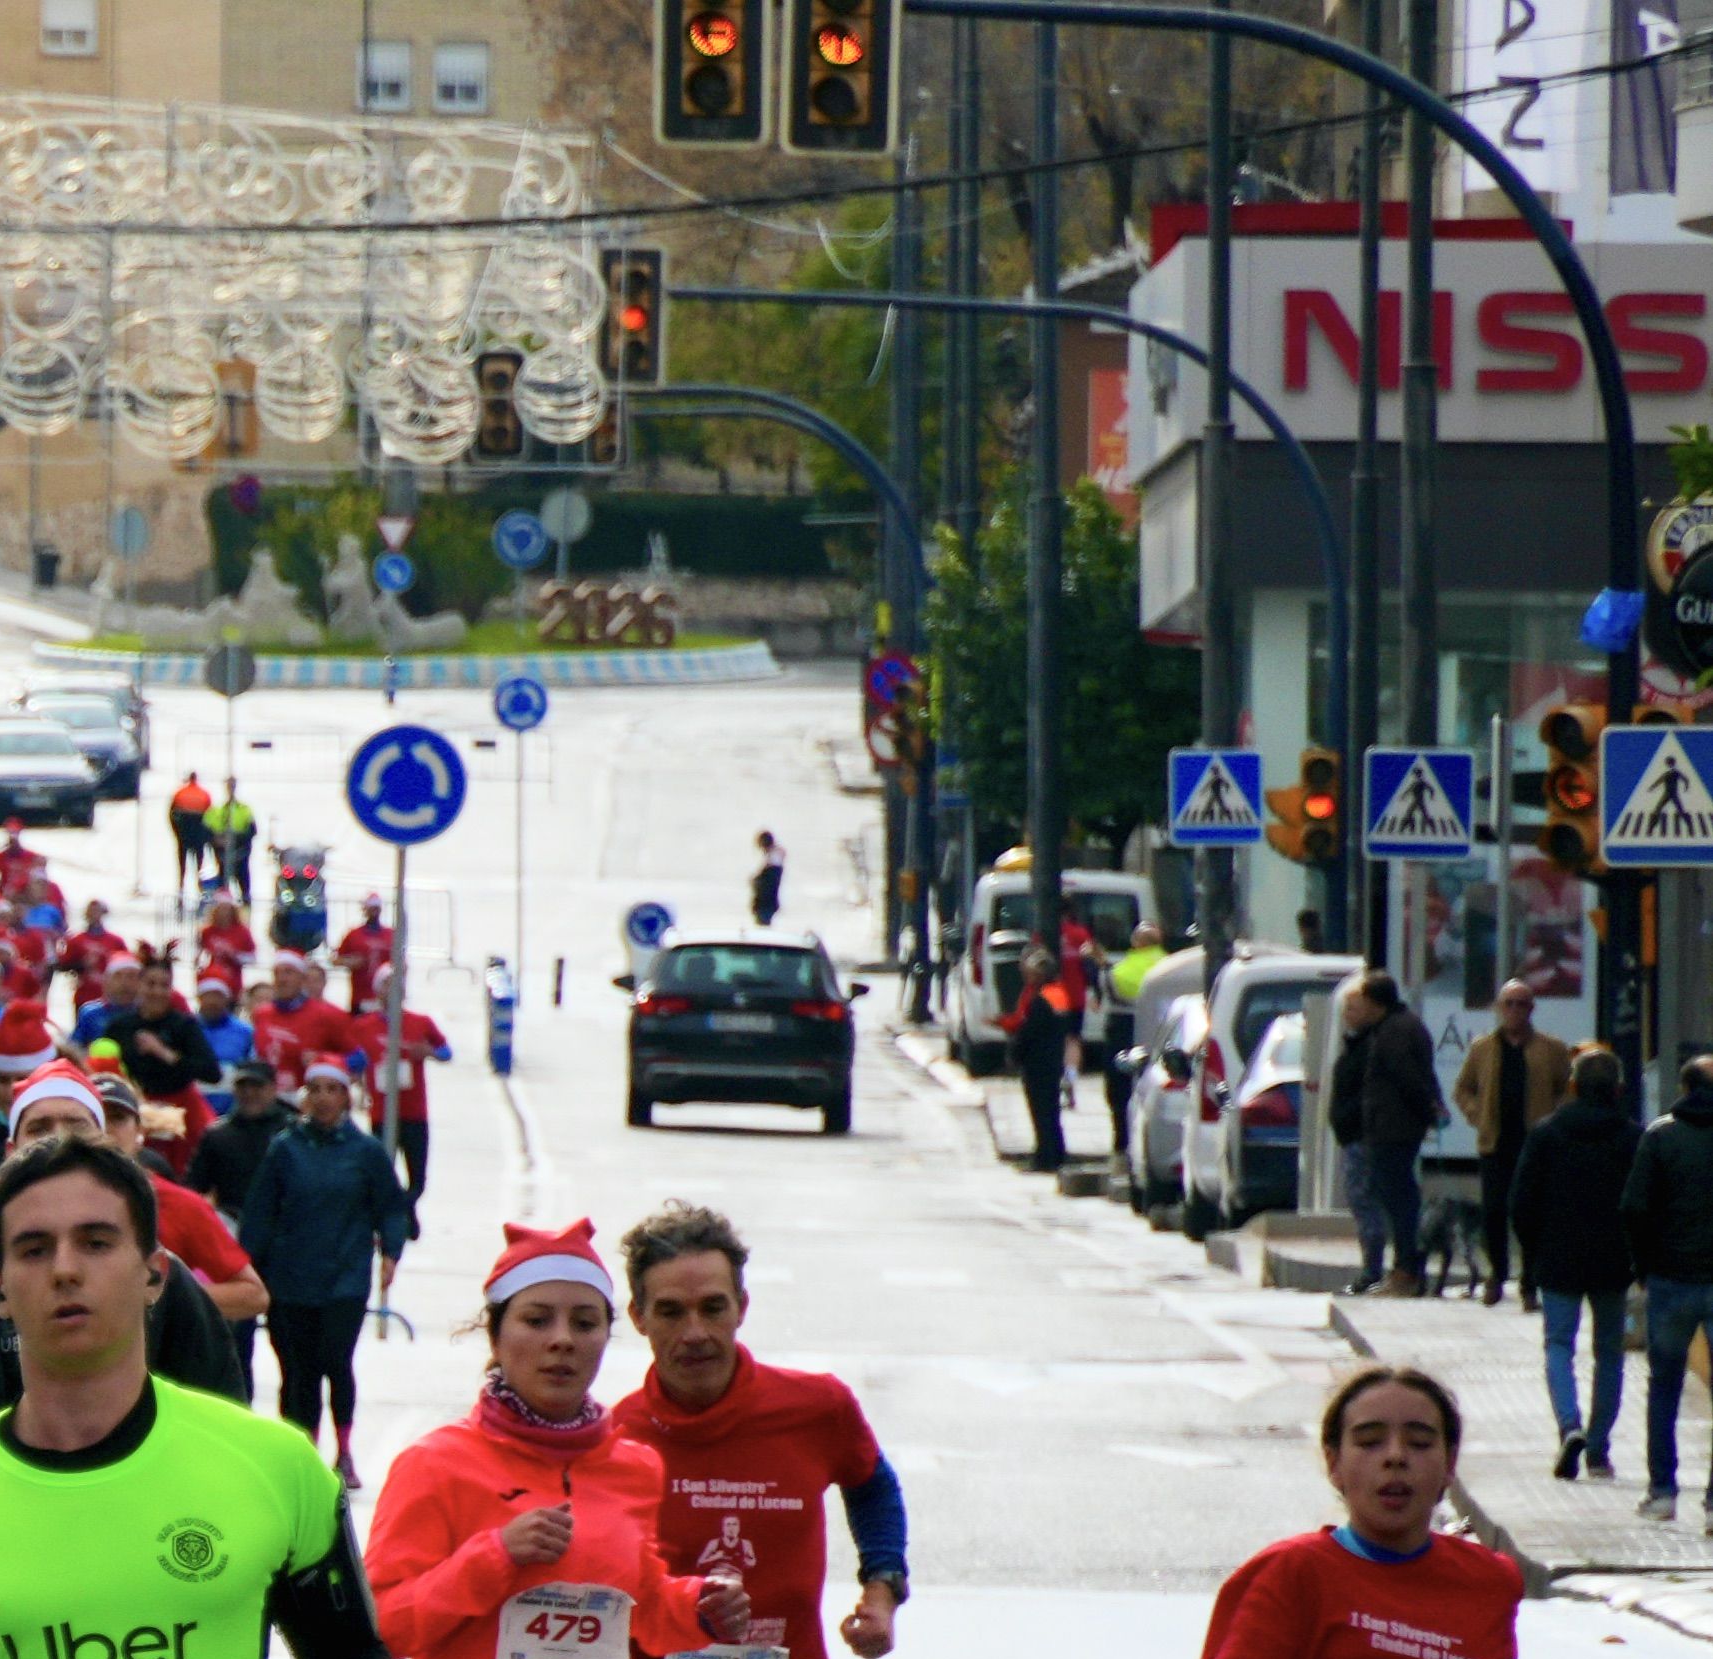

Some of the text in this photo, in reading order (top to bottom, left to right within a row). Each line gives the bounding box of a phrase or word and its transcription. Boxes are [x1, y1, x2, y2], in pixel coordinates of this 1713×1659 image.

[1283, 289, 1707, 394] NISS
[681, 1478, 706, 1493] San
[708, 1478, 766, 1494] Silvestre
[691, 1494, 804, 1510] Ciudad de Lucena
[526, 1612, 601, 1643] 479
[1361, 1614, 1388, 1633] San
